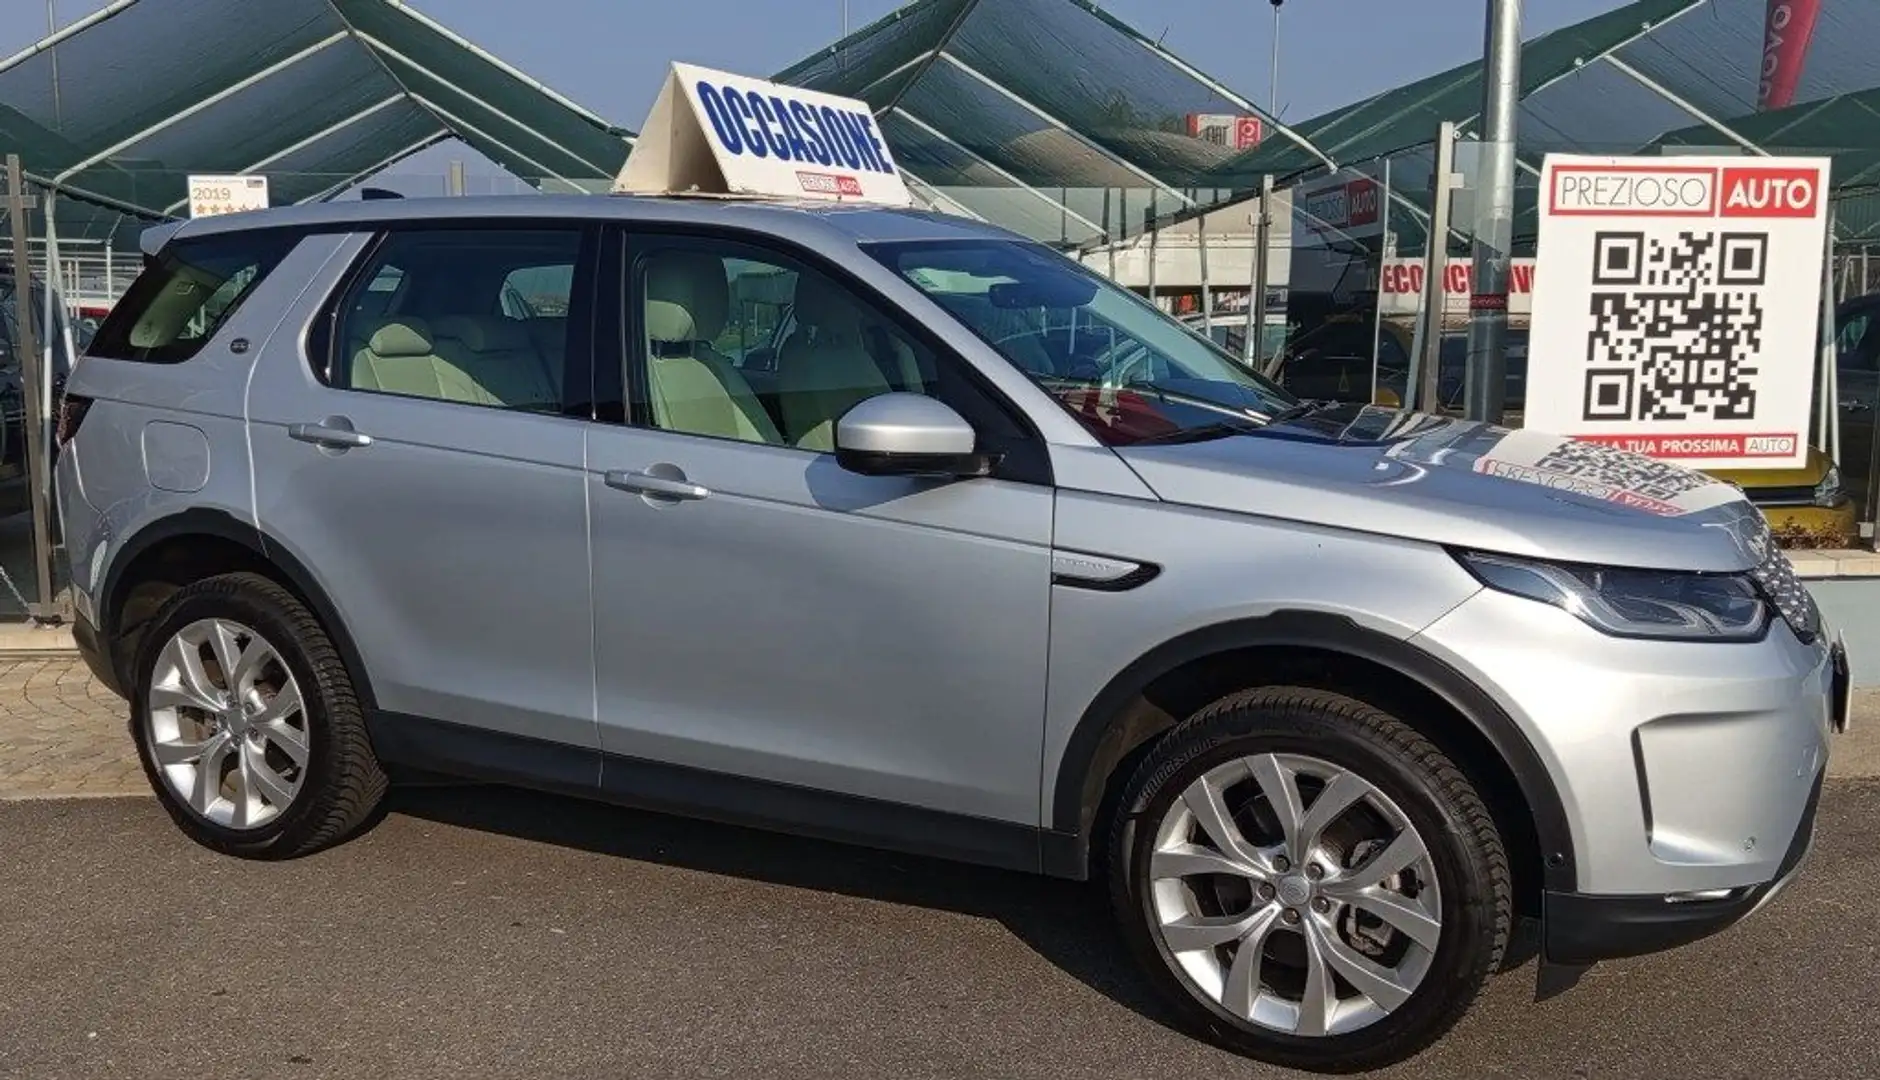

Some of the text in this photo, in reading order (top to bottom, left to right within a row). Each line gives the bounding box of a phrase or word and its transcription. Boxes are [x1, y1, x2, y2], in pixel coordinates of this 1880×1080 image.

[696, 81, 894, 174] OCCASIONE
[192, 187, 231, 201] 2019
[1562, 176, 1812, 210] PREZIOSO AUTO
[1625, 440, 1657, 454] TUA
[1660, 438, 1739, 454] PROSSIMA
[1748, 438, 1792, 453] AUTO
